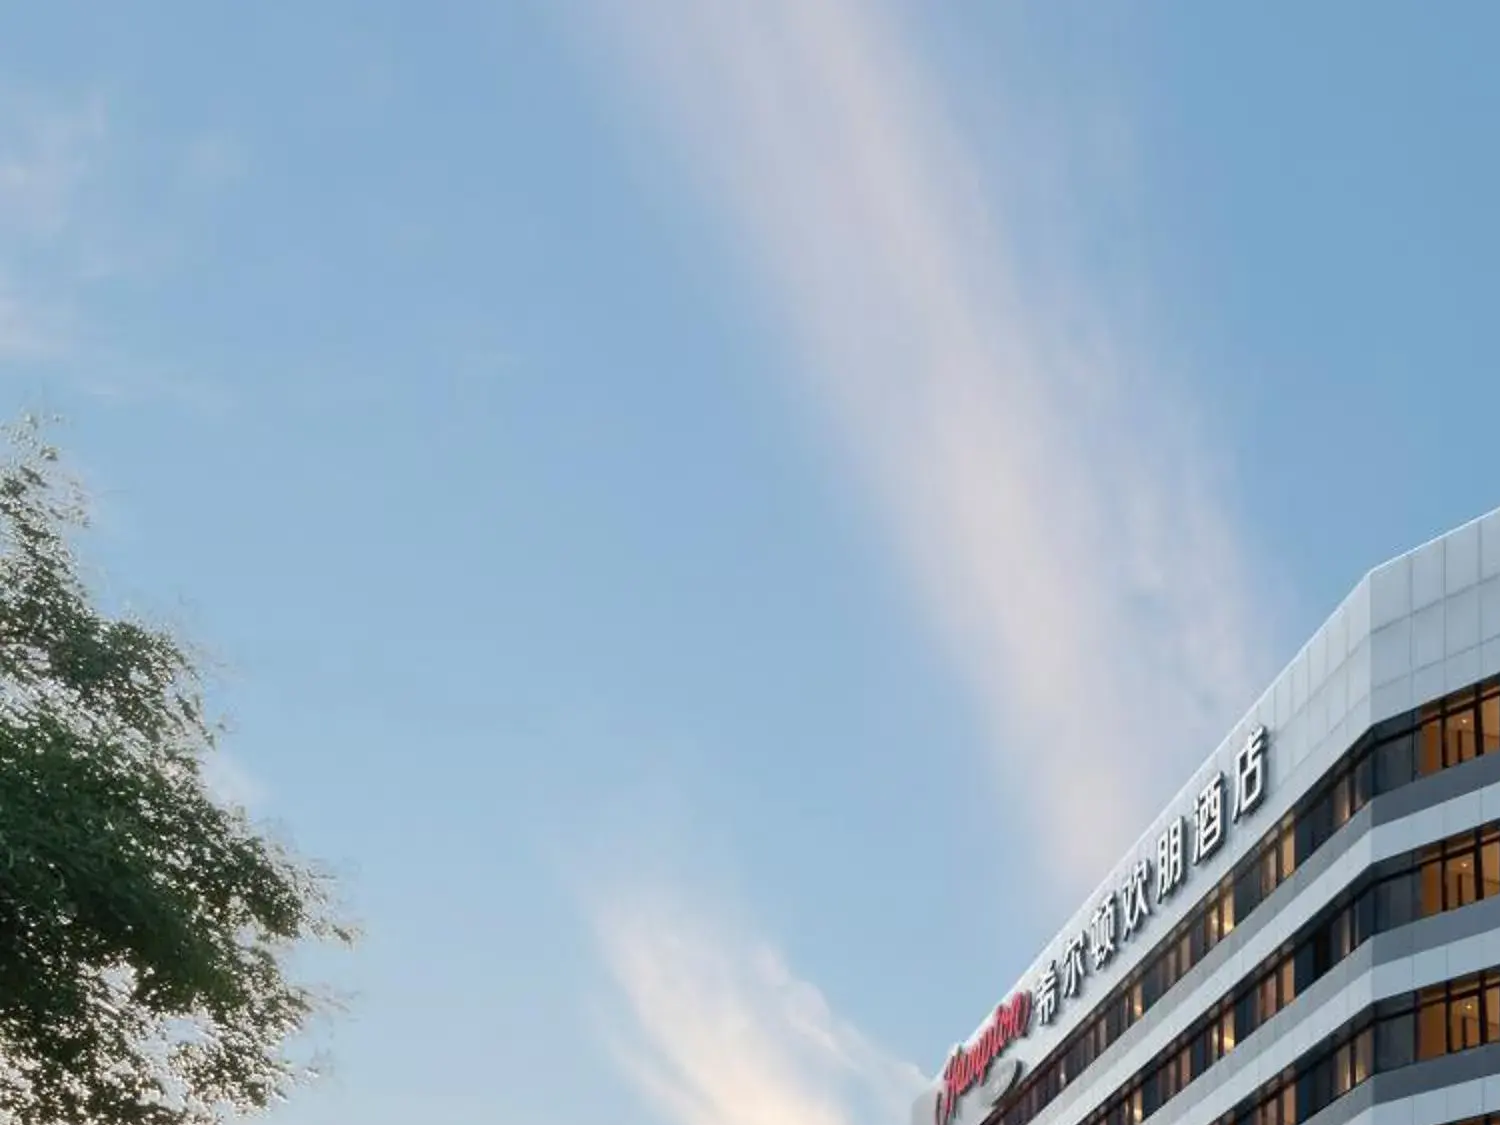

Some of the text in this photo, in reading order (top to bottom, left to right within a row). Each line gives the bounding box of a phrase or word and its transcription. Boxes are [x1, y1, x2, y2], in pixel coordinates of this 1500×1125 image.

[1035, 726, 1266, 1026] 希尔顿欢朋酒店
